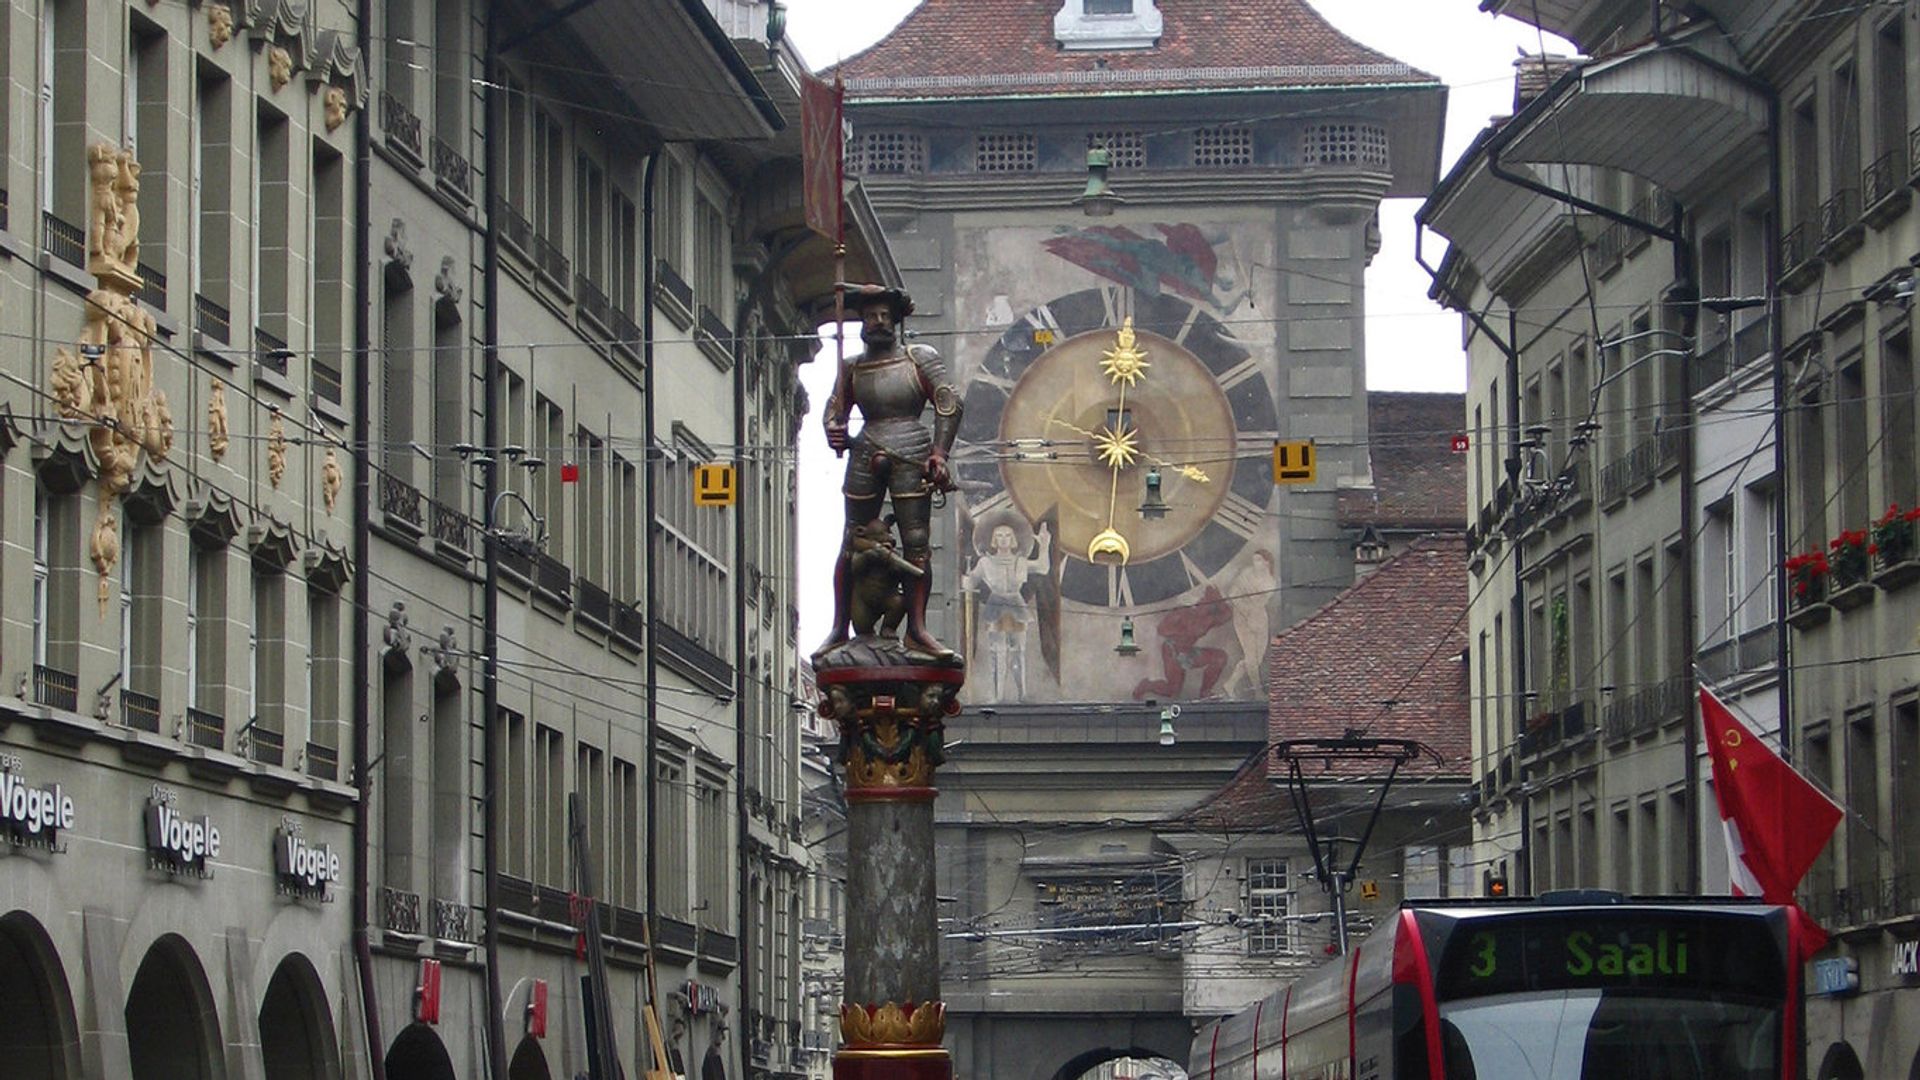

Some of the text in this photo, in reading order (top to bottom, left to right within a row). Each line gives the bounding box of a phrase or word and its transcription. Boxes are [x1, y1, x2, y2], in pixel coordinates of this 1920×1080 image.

[0, 772, 74, 833] Vögele
[158, 805, 220, 862] Vögele
[287, 834, 340, 886] Vögele
[1470, 929, 1689, 977] 3 Saali
